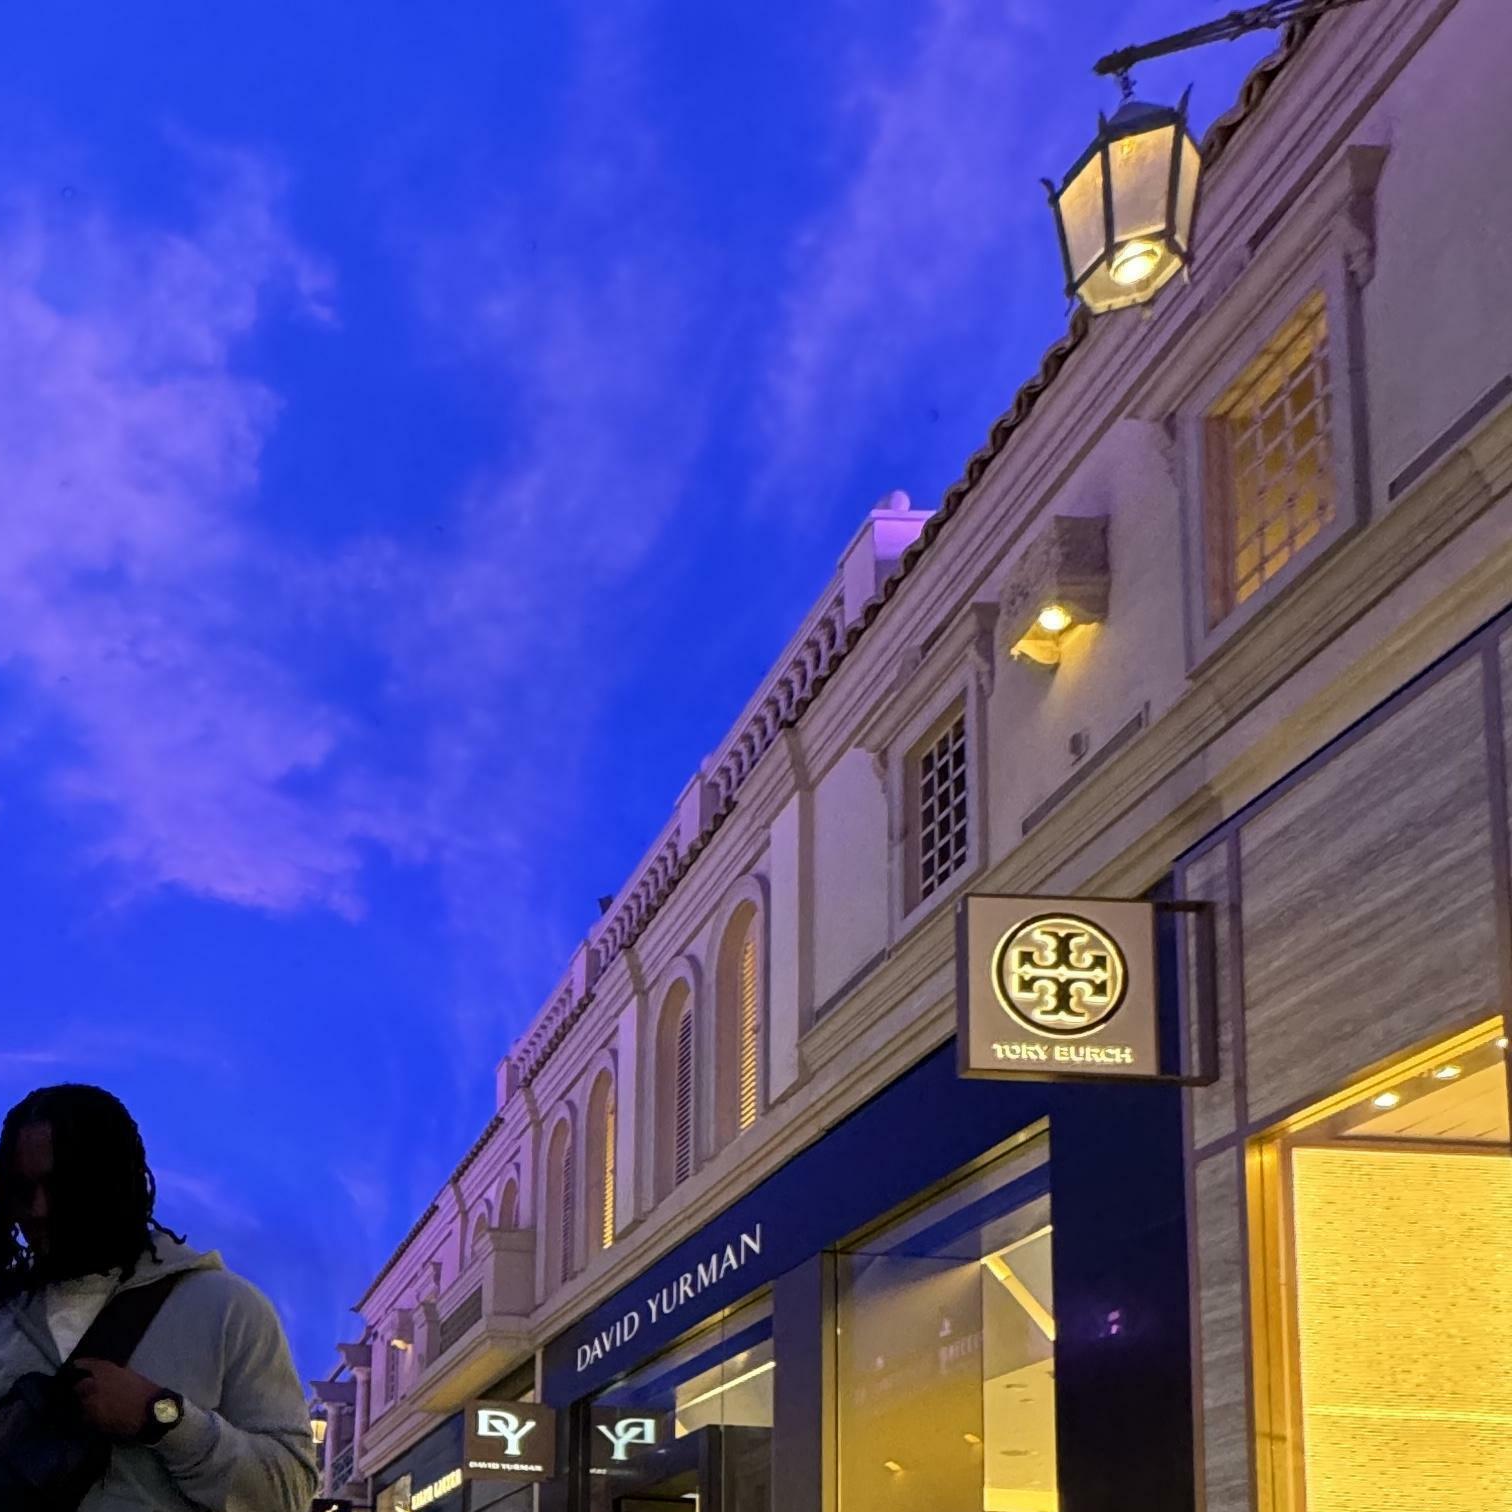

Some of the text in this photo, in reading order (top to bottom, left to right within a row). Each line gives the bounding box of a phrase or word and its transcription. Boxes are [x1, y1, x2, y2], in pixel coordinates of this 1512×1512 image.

[992, 1043, 1134, 1064] TORY BURCH
[577, 1223, 761, 1372] DAVID YURMAN
[476, 1410, 536, 1455] DY
[469, 1461, 543, 1472] DAVID YURMAN
